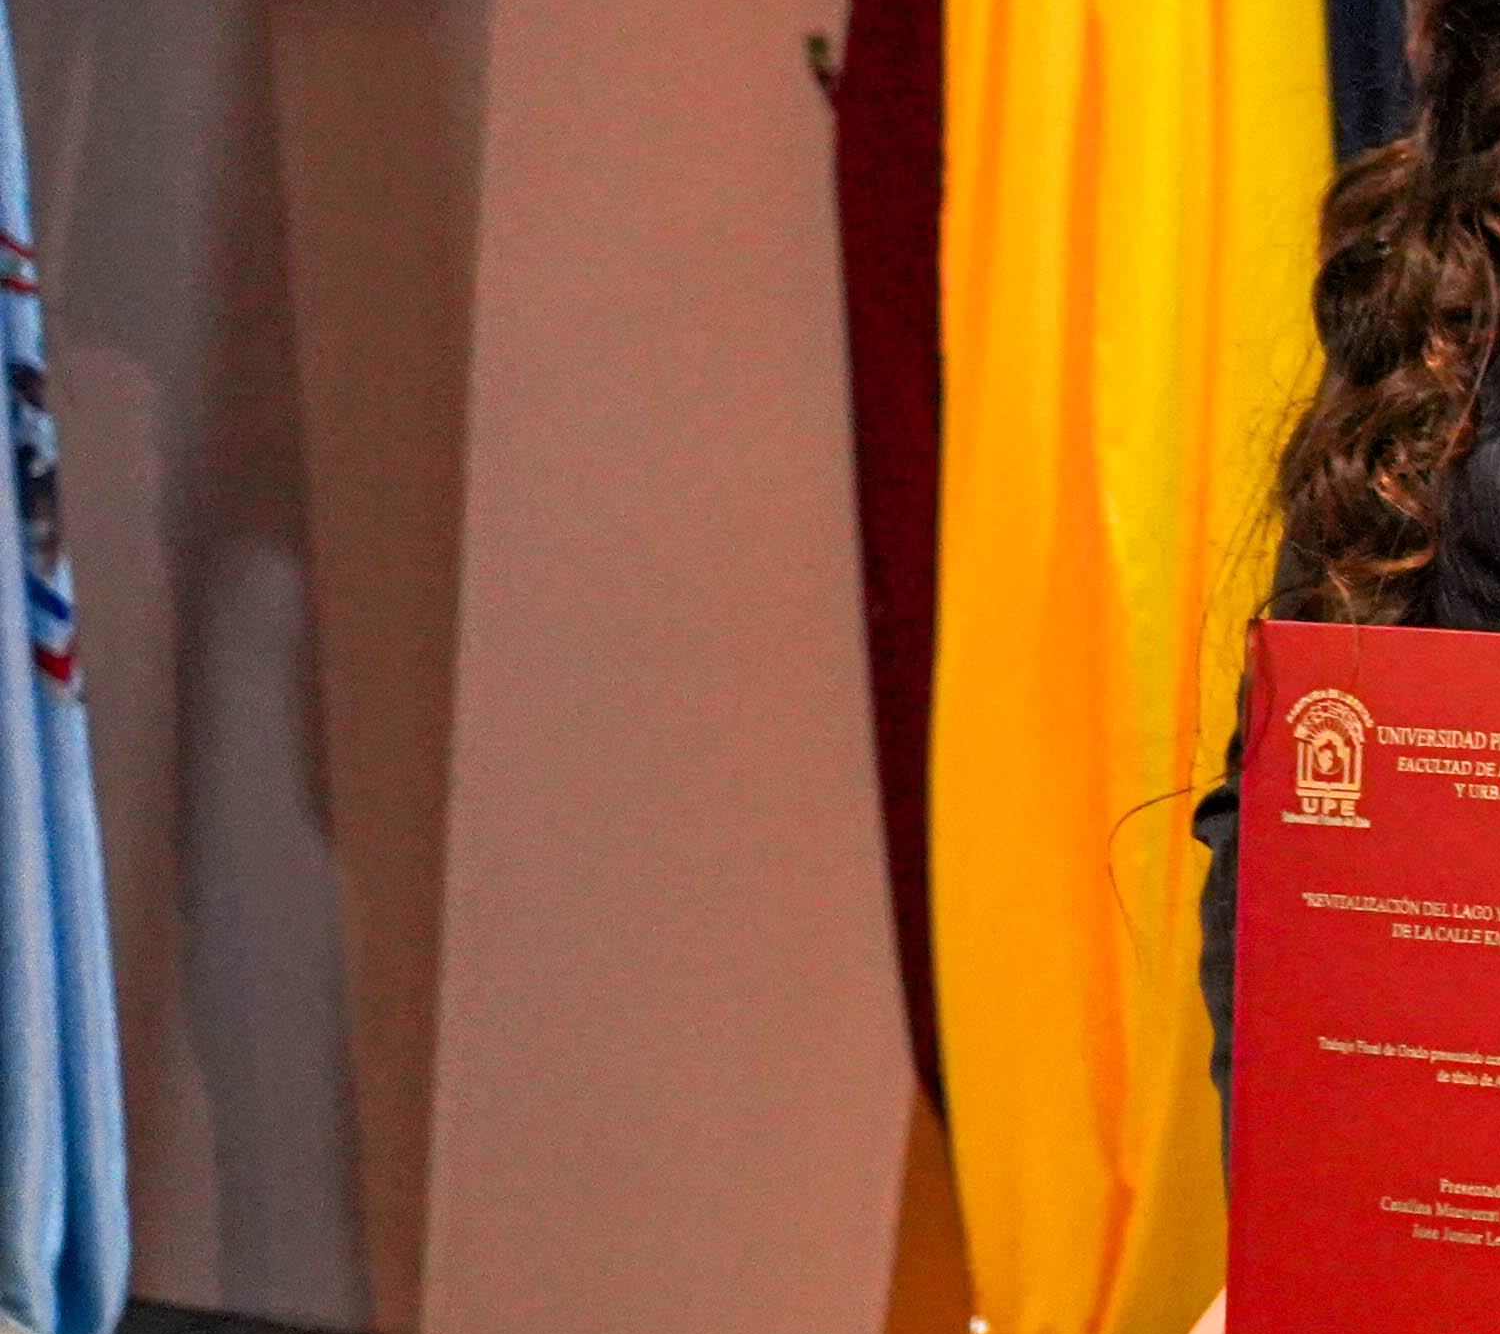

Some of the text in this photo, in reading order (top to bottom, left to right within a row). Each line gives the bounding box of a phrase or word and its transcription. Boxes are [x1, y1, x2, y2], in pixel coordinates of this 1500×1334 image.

[1397, 756, 1472, 775] FACULTAD
[1474, 761, 1496, 777] DE
[1453, 782, 1466, 798] Y
[1302, 797, 1356, 818] UPE
[1422, 901, 1451, 917] DEL
[1452, 903, 1493, 921] LAGO
[1391, 923, 1412, 939] DE
[1413, 924, 1433, 940] LA
[1434, 926, 1482, 944] CALLE
